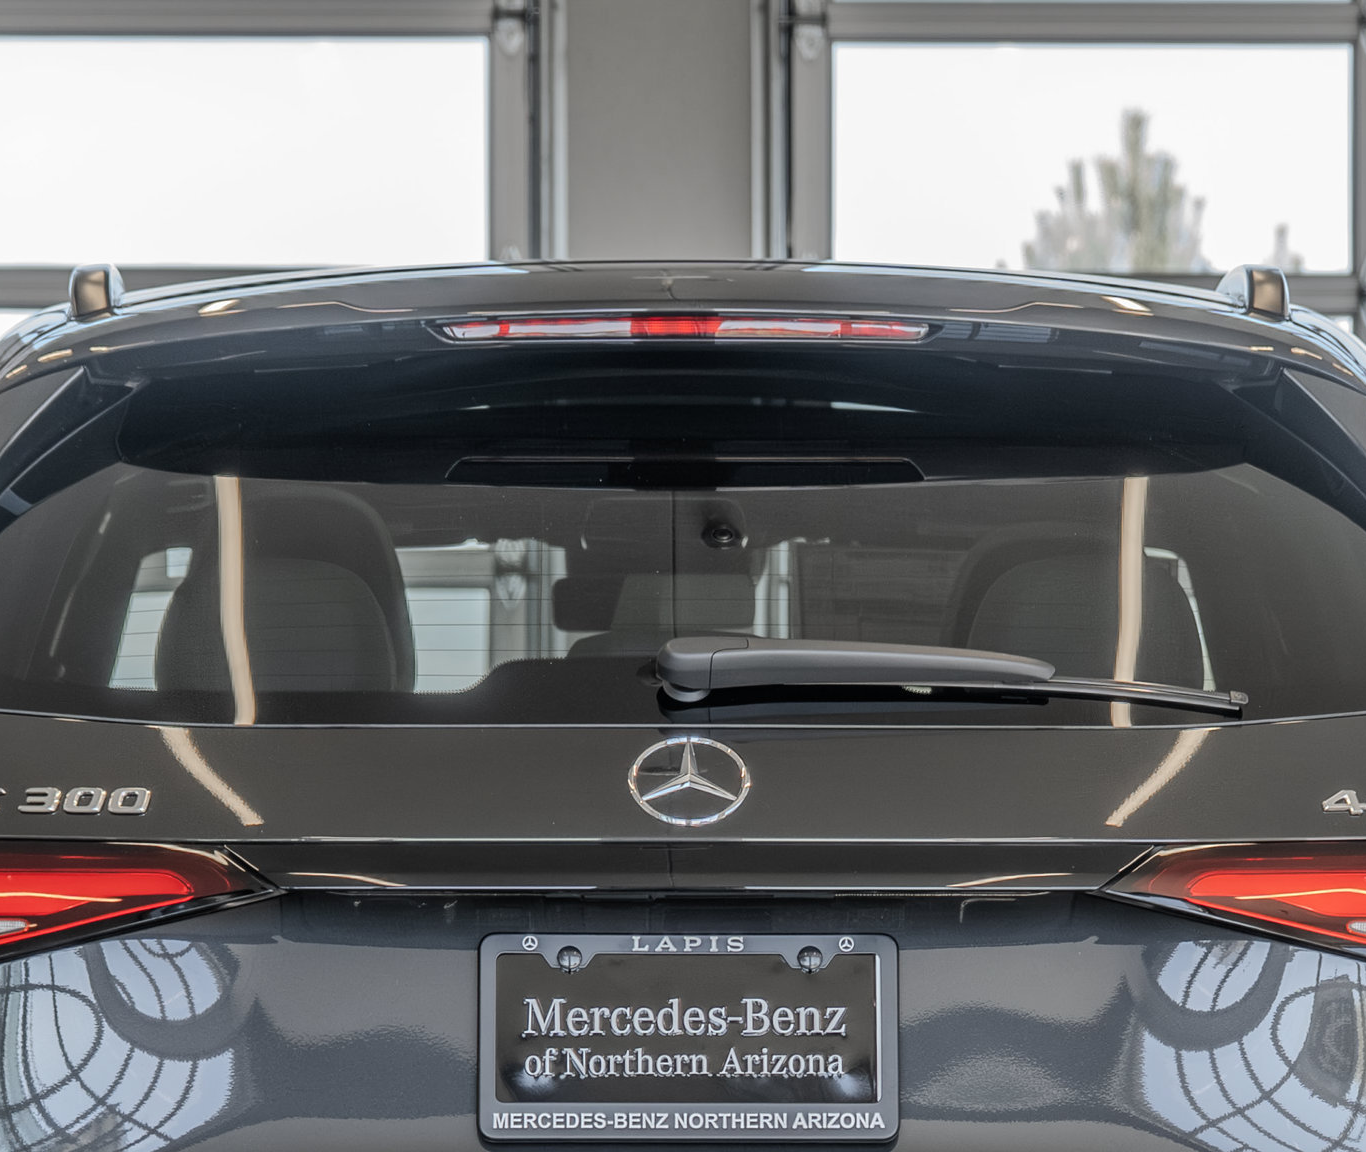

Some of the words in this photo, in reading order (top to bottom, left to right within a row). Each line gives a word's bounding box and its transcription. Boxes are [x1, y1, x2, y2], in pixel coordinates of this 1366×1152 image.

[17, 787, 151, 816] 300
[631, 936, 745, 952] LAPIS
[522, 998, 847, 1038] Mercedes-Benz
[524, 1047, 558, 1077] of
[562, 1047, 711, 1079] Northern
[719, 1047, 845, 1078] Arizona
[492, 1112, 669, 1130] MERCEDES-BENZ
[674, 1112, 787, 1130] NORTHERN
[792, 1112, 885, 1130] ARIZONA
